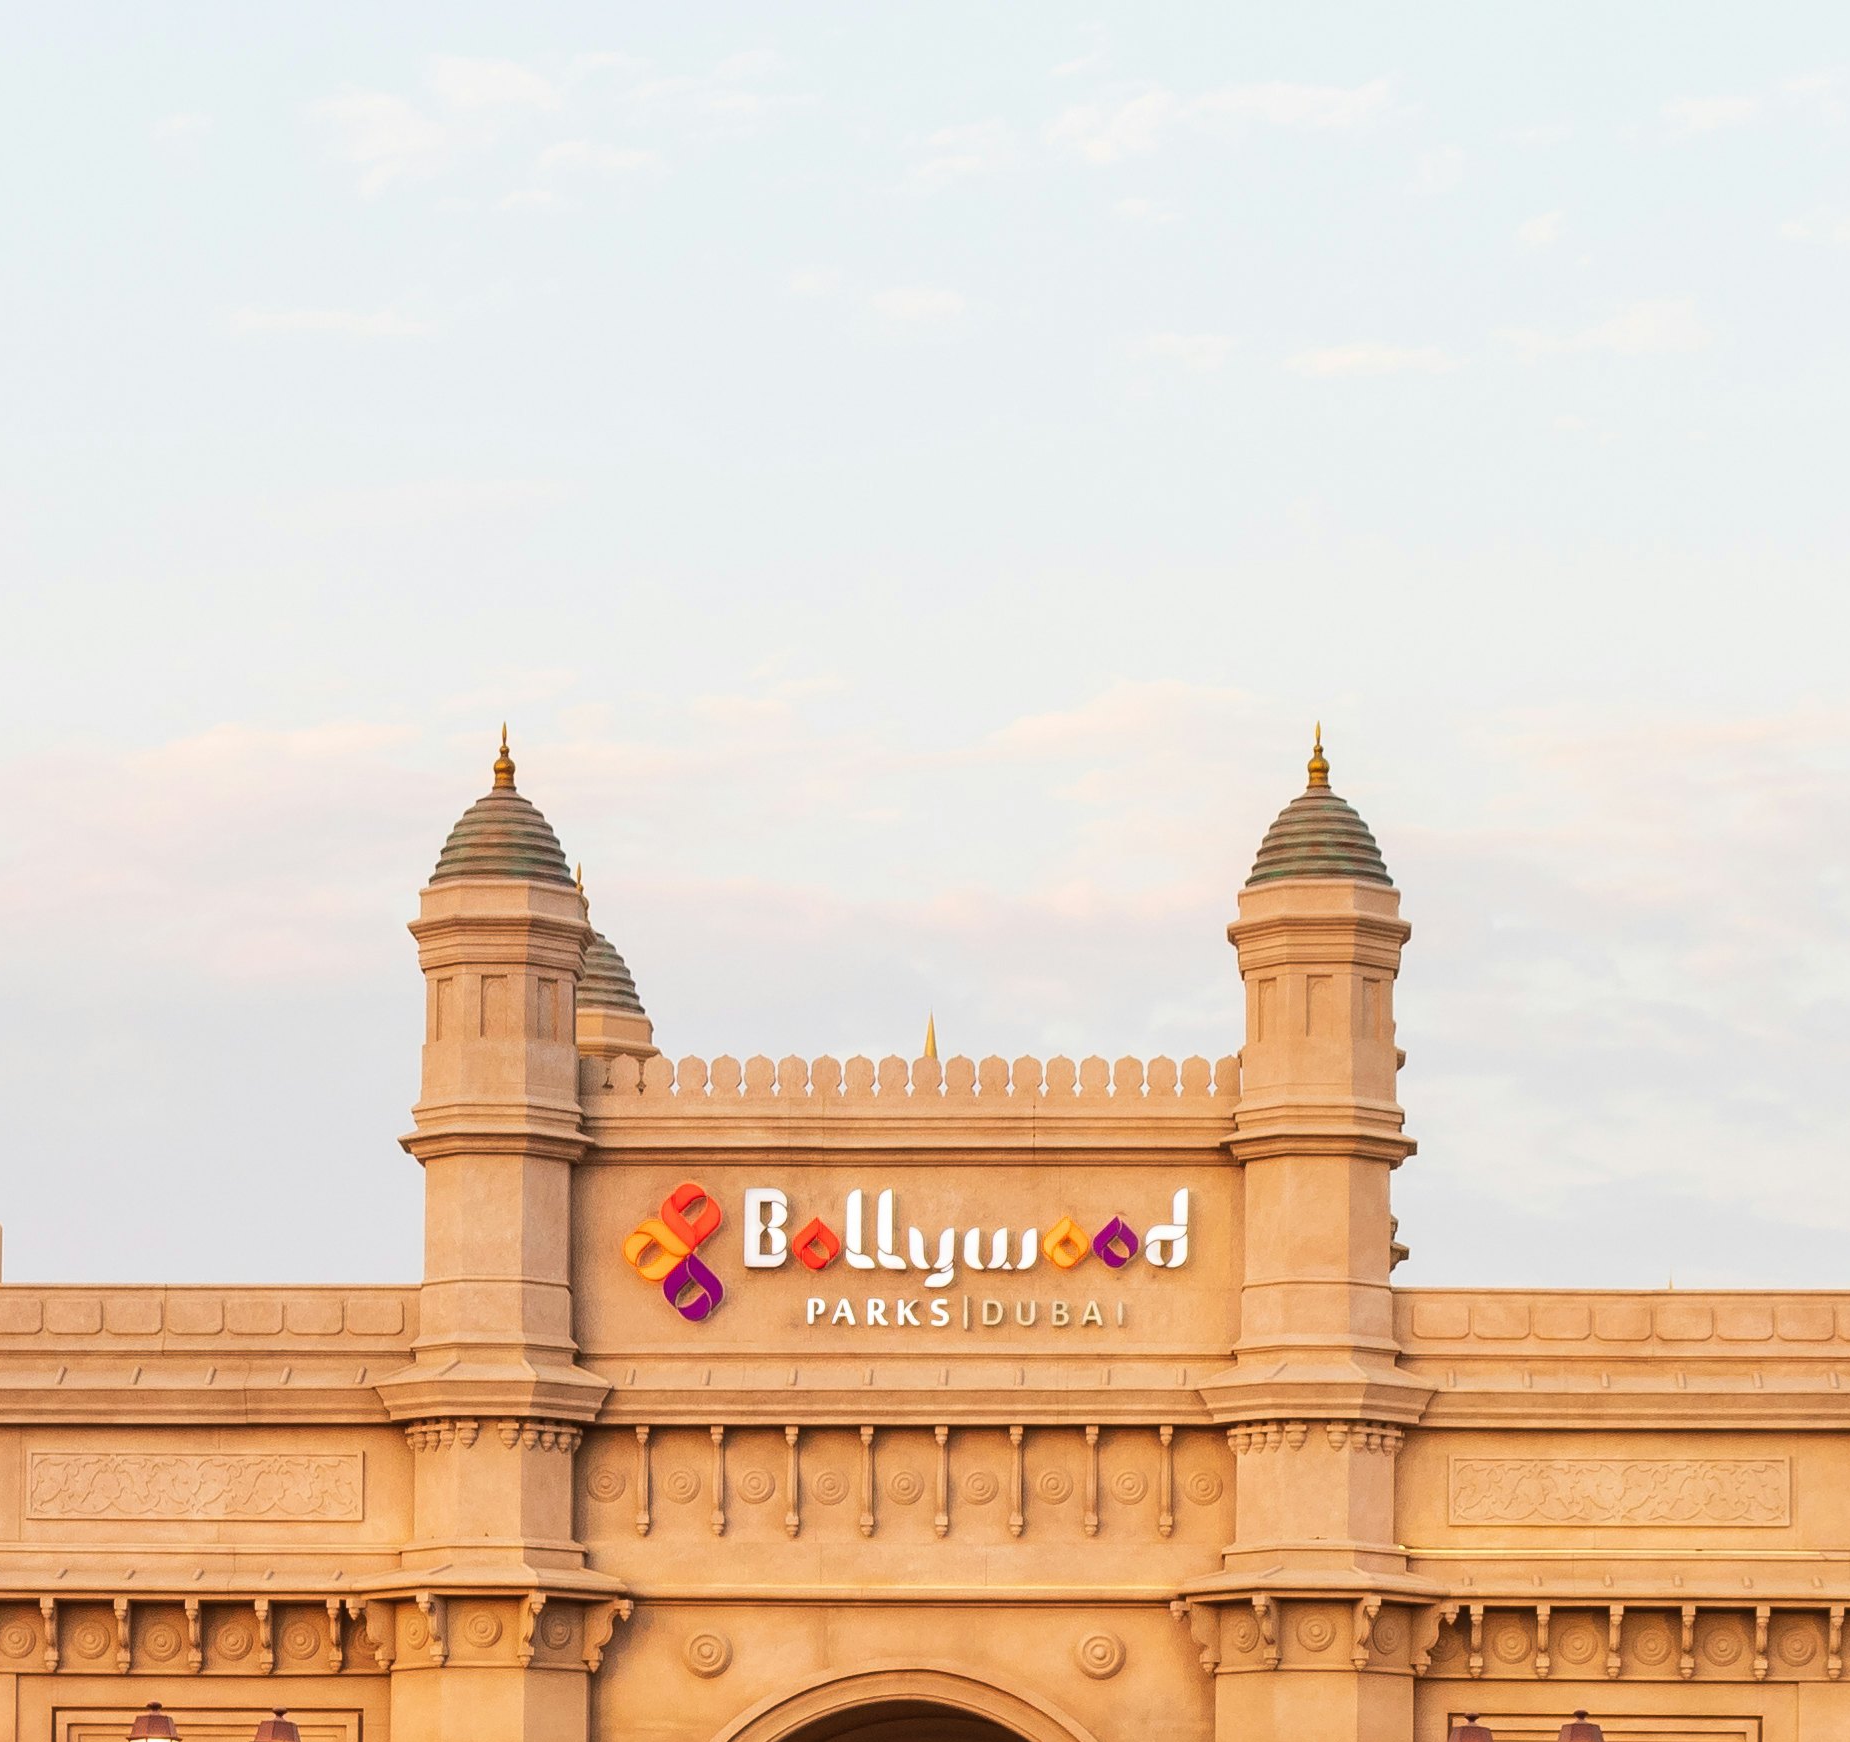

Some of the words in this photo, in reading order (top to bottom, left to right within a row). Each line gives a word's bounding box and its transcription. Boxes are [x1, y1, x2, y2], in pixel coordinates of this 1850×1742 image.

[743, 1185, 1190, 1289] Bollywood
[806, 1297, 951, 1327] PARKS
[982, 1300, 1125, 1327] DUBAI
